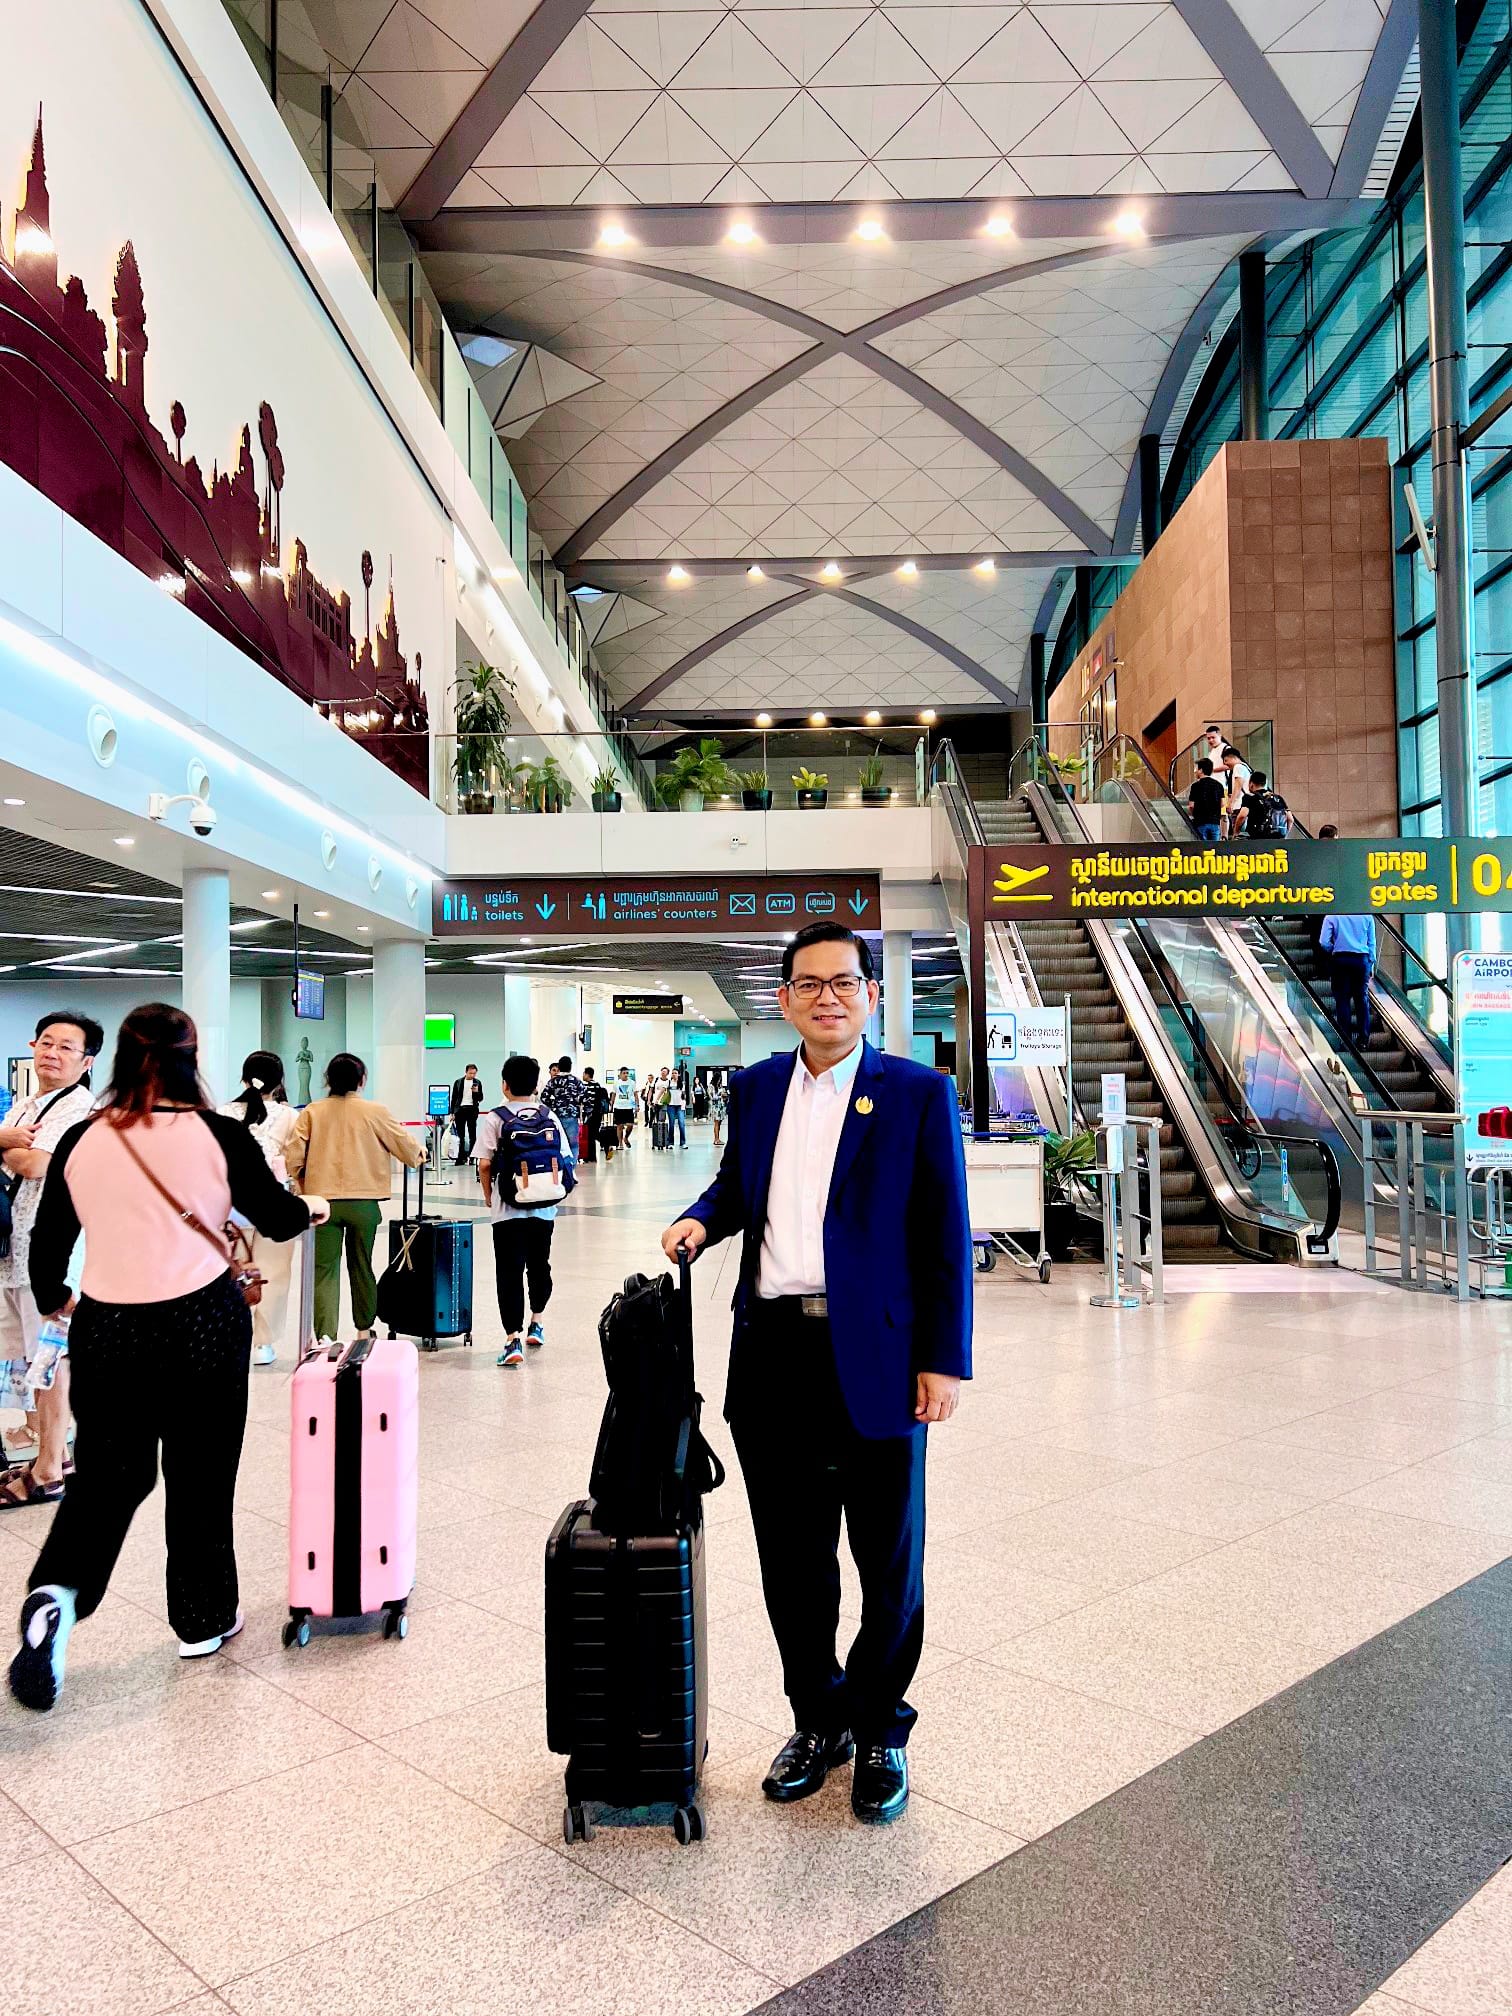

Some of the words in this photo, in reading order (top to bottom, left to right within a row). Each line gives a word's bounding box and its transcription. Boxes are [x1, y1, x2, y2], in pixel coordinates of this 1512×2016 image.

[1071, 884, 1208, 907] international
[1212, 883, 1335, 909] departures
[1370, 881, 1438, 907] gates
[770, 899, 791, 908] ATM
[485, 910, 524, 921] toilets
[663, 908, 718, 919] counters
